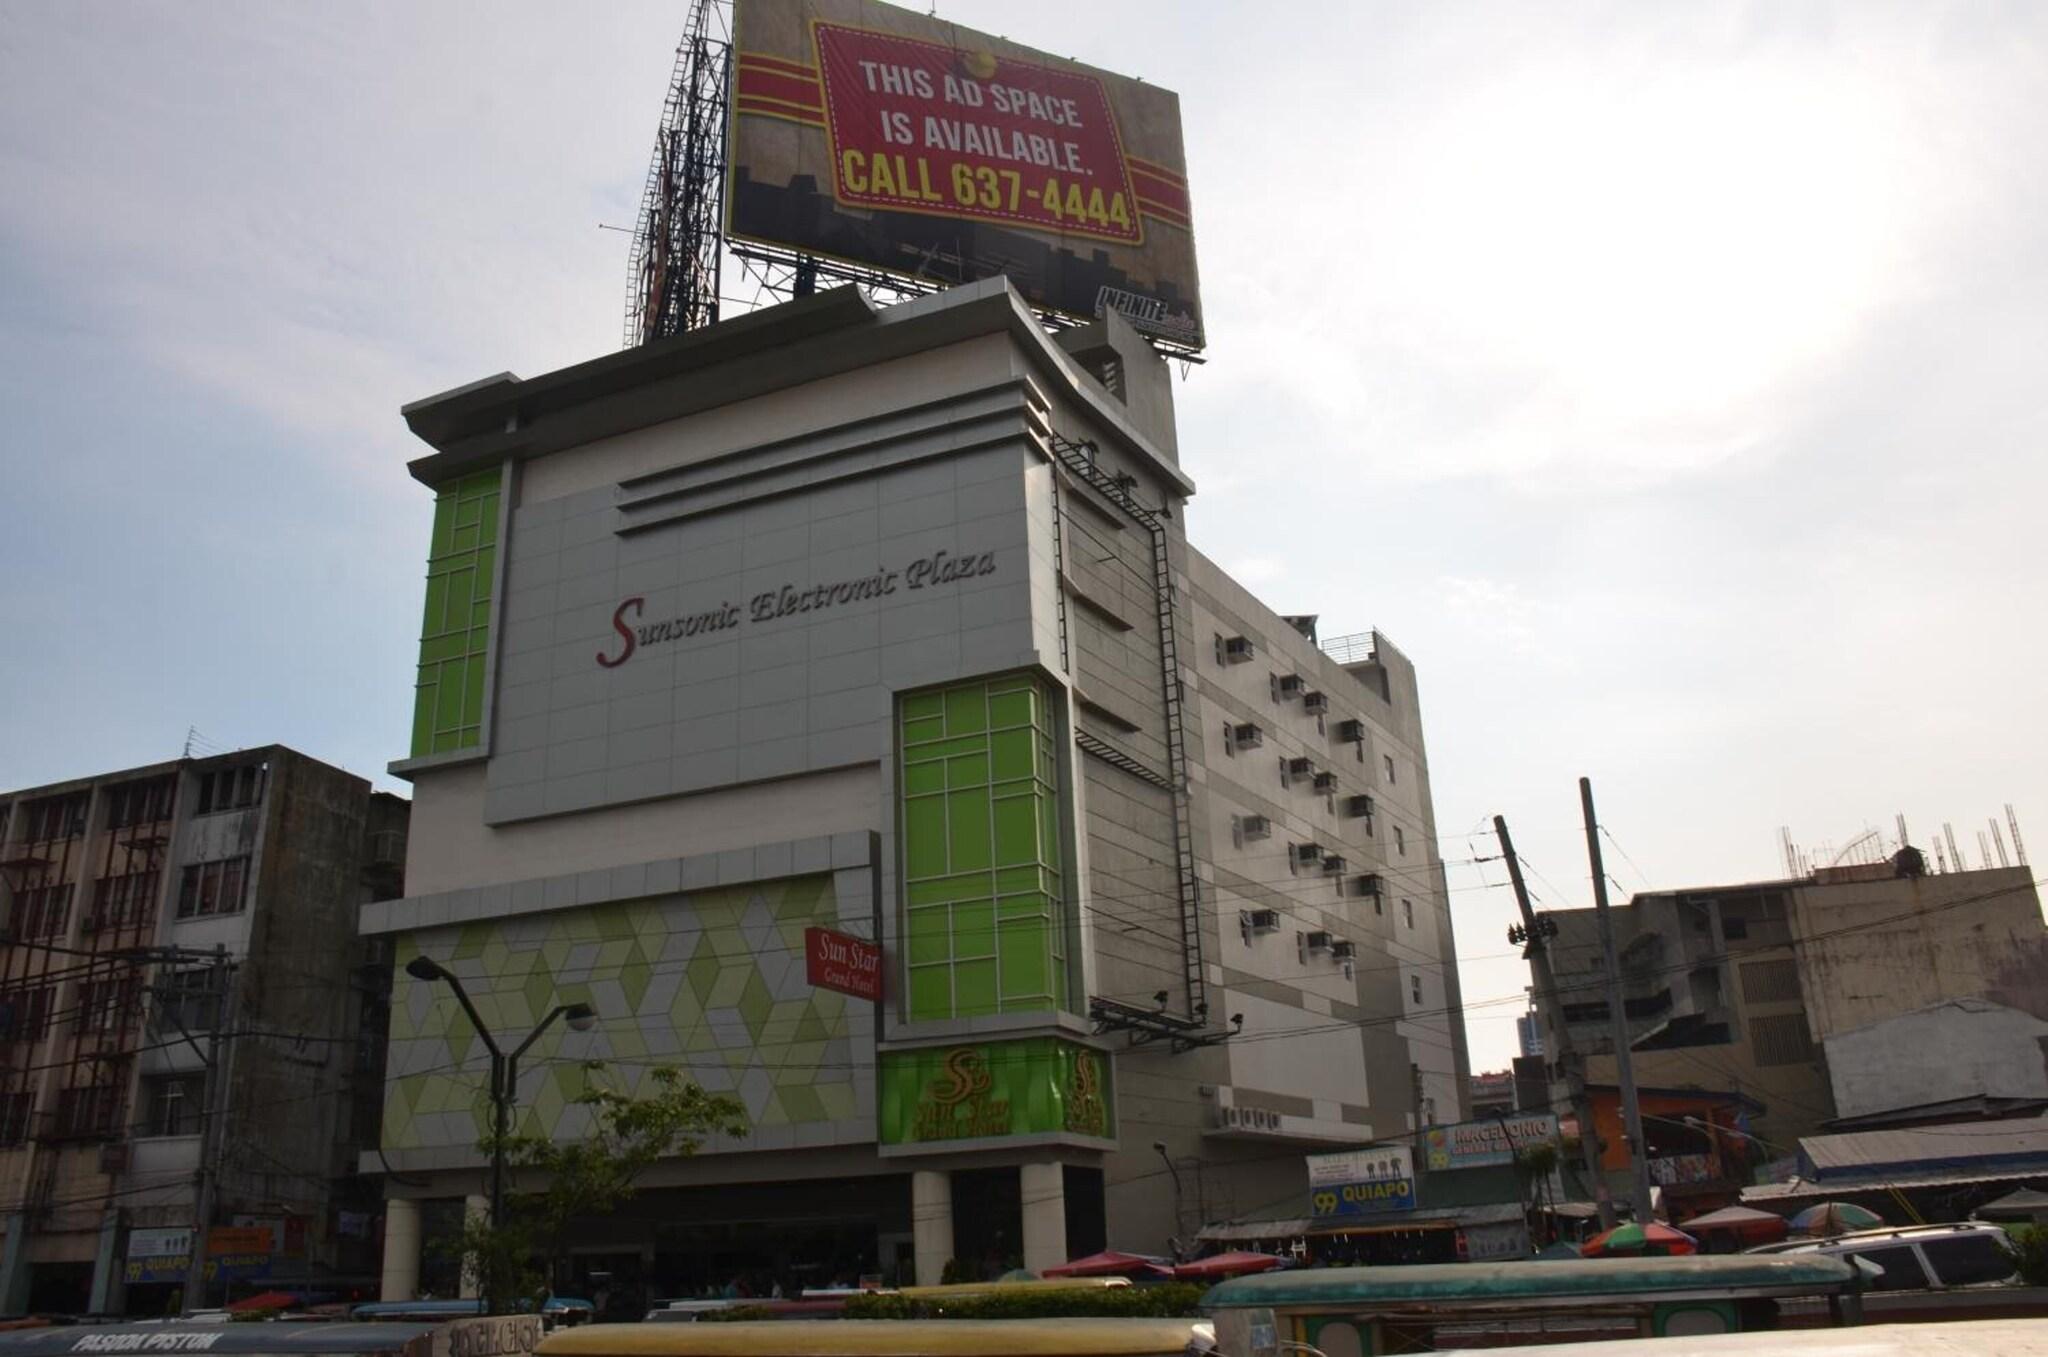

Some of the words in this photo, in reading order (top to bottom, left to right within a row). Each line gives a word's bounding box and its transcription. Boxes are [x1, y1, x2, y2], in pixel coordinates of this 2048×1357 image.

[859, 60, 935, 100] THIS
[944, 76, 983, 108] AD
[992, 82, 1083, 127] SPACE
[881, 110, 913, 145] IS
[924, 116, 1093, 176] AVAILABLE.
[842, 149, 945, 202] CALL
[952, 162, 1131, 232] 637-4444
[1097, 286, 1168, 322] INFINITE
[596, 597, 741, 668] Sunsonic
[750, 567, 899, 624] Electronic
[905, 549, 997, 590] Plaza
[817, 933, 847, 964] Sun
[849, 942, 880, 973] Star
[1314, 1191, 1338, 1214] 99
[1343, 1181, 1408, 1202] QUIAPO
